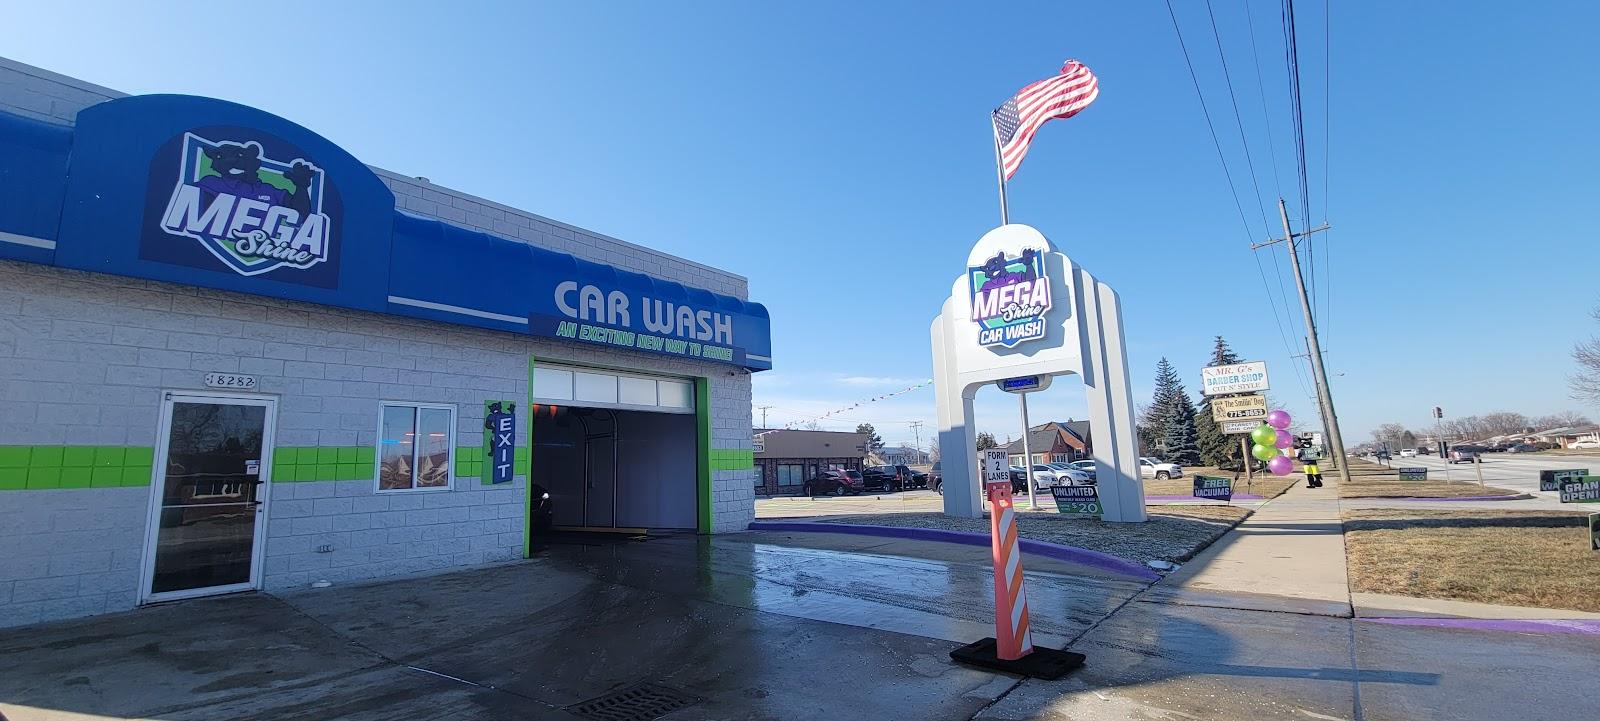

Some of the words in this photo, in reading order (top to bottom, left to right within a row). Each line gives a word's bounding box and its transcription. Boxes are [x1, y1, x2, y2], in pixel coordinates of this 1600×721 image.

[165, 183, 324, 255] MEGA
[232, 230, 314, 262] Shine
[973, 277, 1050, 319] MEGA
[554, 281, 630, 327] CAR
[642, 296, 733, 345] WASH
[1001, 302, 1042, 322] Shine
[980, 329, 1003, 344] CAR
[1005, 320, 1042, 340] WASH
[556, 321, 577, 338] AN
[579, 324, 636, 347] EXCITING
[636, 334, 664, 352] NEW
[665, 337, 688, 355] WAY
[689, 342, 701, 356] TO
[703, 345, 733, 361] SHINE!
[209, 374, 254, 387] 18282
[1206, 376, 1240, 386] BARBER
[1242, 373, 1264, 382] SHOP
[1254, 398, 1264, 406] Dog
[1229, 409, 1263, 418] 775-8653
[498, 416, 513, 478] EXIT
[987, 451, 1006, 460] FORM
[996, 462, 1000, 470] 2
[988, 472, 1008, 480] LANES
[1205, 479, 1228, 488] FREE
[1542, 482, 1558, 490] WA
[1566, 481, 1599, 492] GRAN
[1053, 487, 1094, 496] UNLIMITED
[1195, 487, 1230, 496] VACUUMS
[1562, 492, 1599, 502] OPENI
[1072, 502, 1098, 513] $20
